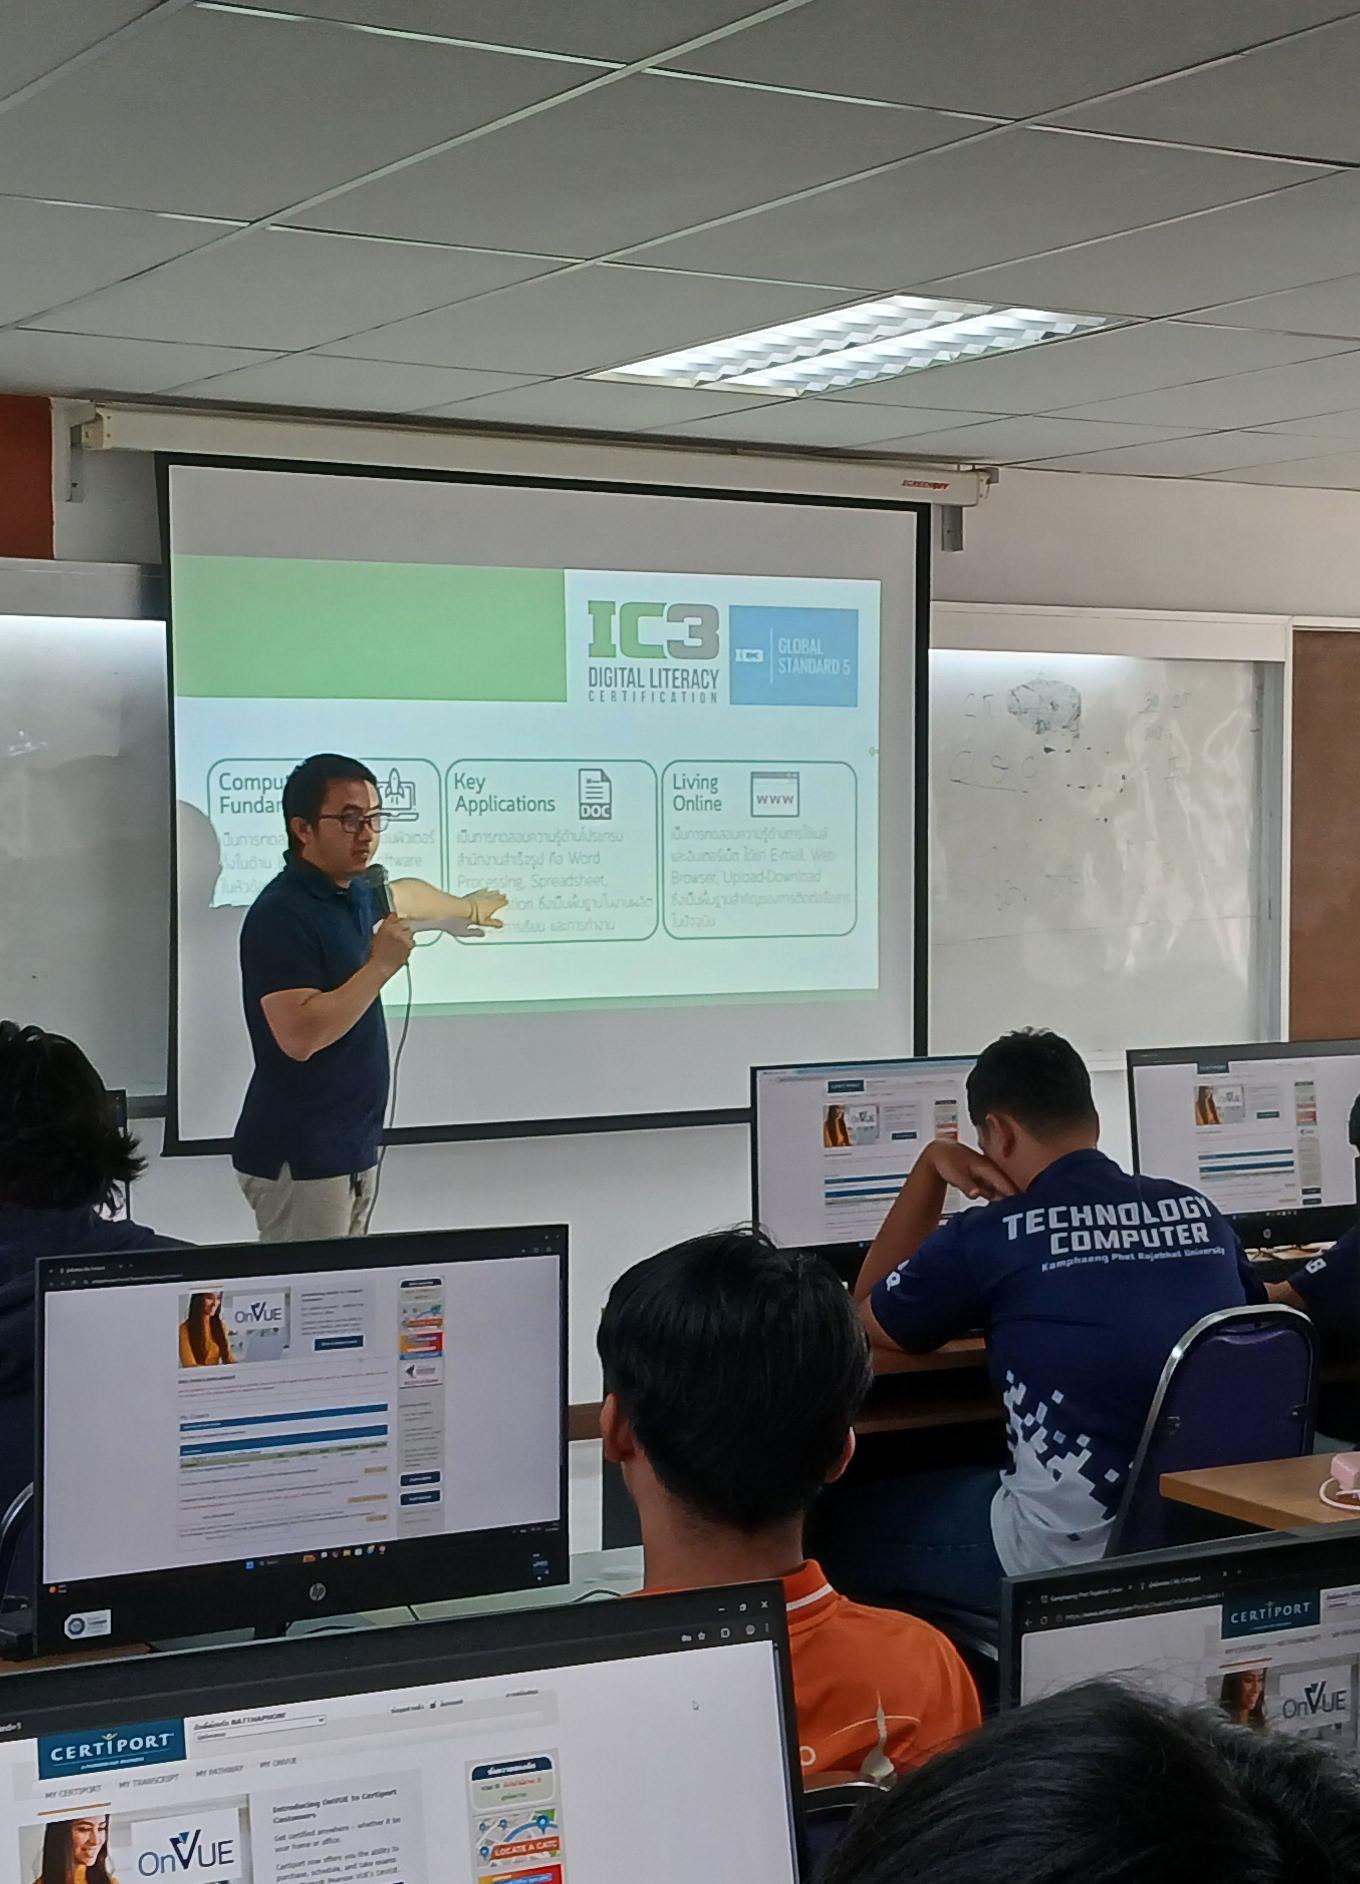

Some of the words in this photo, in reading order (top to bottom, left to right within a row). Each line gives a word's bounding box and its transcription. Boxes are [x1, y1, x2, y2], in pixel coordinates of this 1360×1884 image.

[588, 600, 719, 660] IC3
[778, 638, 823, 654] GLOBAL
[778, 658, 840, 674] STANDARD
[843, 660, 851, 675] 5
[589, 667, 645, 688] DIGITAL
[650, 668, 719, 689] LITERACY
[589, 691, 718, 704] CERTIFICATION
[454, 773, 486, 794] Key
[673, 773, 719, 794] Living
[455, 795, 556, 816] Applications
[580, 805, 611, 818] DOC
[673, 795, 722, 811] Online
[568, 851, 601, 865] Word
[1002, 1196, 1213, 1241] TECHNOLOGY
[1050, 1222, 1210, 1255] COMPUTER
[234, 1302, 282, 1324] OnVUE
[1230, 1601, 1311, 1624] CERTIPORT
[1282, 1681, 1347, 1720] OnVUE
[50, 1732, 170, 1762] CERTIPORT
[45, 1791, 56, 1799] MY
[119, 1780, 131, 1788] MY
[196, 1769, 208, 1777] MY
[273, 1801, 320, 1813] Introducing
[361, 1789, 397, 1800] Certiport
[274, 1834, 286, 1842] Get
[138, 1829, 235, 1877] OnVUE
